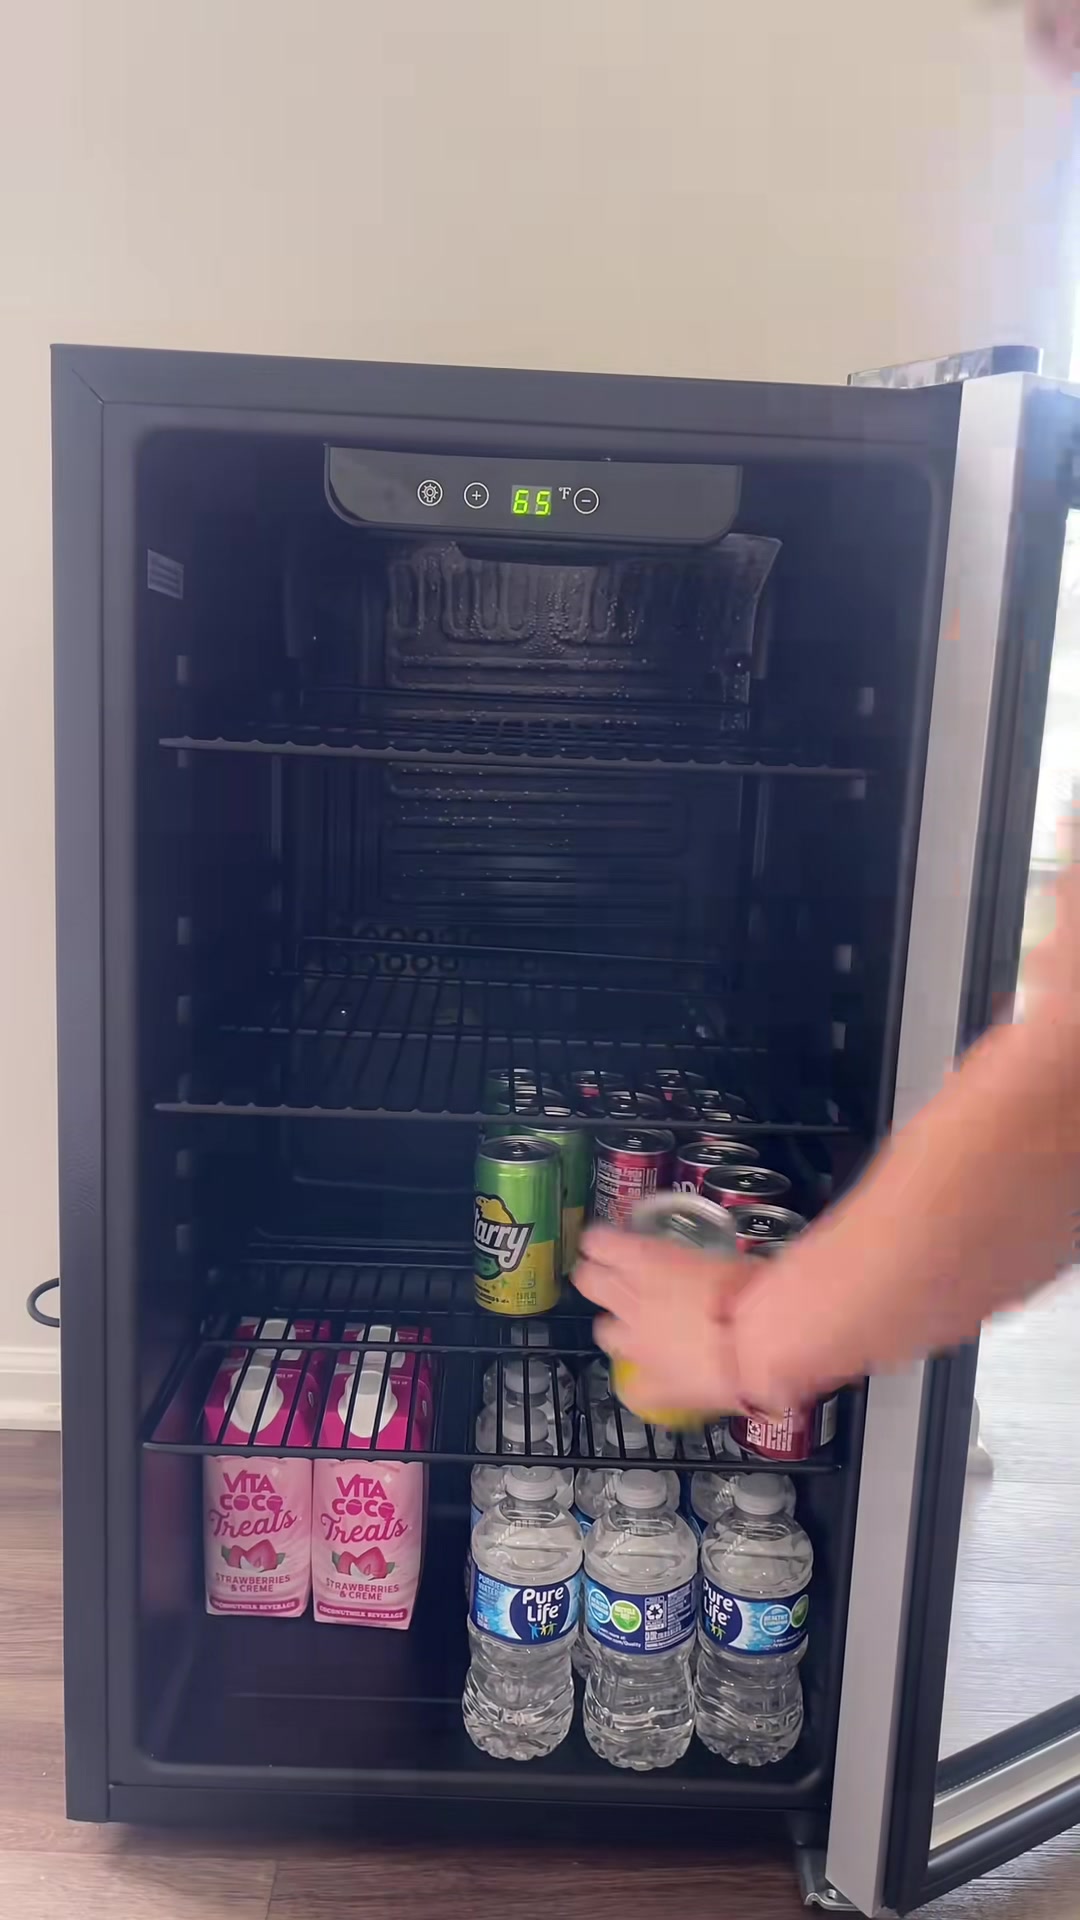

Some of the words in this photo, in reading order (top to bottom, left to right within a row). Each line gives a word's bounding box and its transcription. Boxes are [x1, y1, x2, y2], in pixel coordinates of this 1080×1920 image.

[512, 489, 550, 515] 65
[475, 1207, 529, 1269] tarry
[223, 1469, 276, 1494] VITA
[336, 1474, 388, 1500] VITA
[220, 1494, 283, 1511] COCO
[332, 1498, 394, 1519] COCO
[209, 1507, 297, 1539] Treats
[320, 1513, 408, 1544] Treats
[215, 1572, 291, 1586] STRAWBERRIES
[326, 1578, 400, 1593] STRAWBERRIES
[340, 1590, 347, 1598] &
[522, 1587, 564, 1605] Pure
[527, 1603, 560, 1625] Life
[704, 1595, 728, 1626] Life
